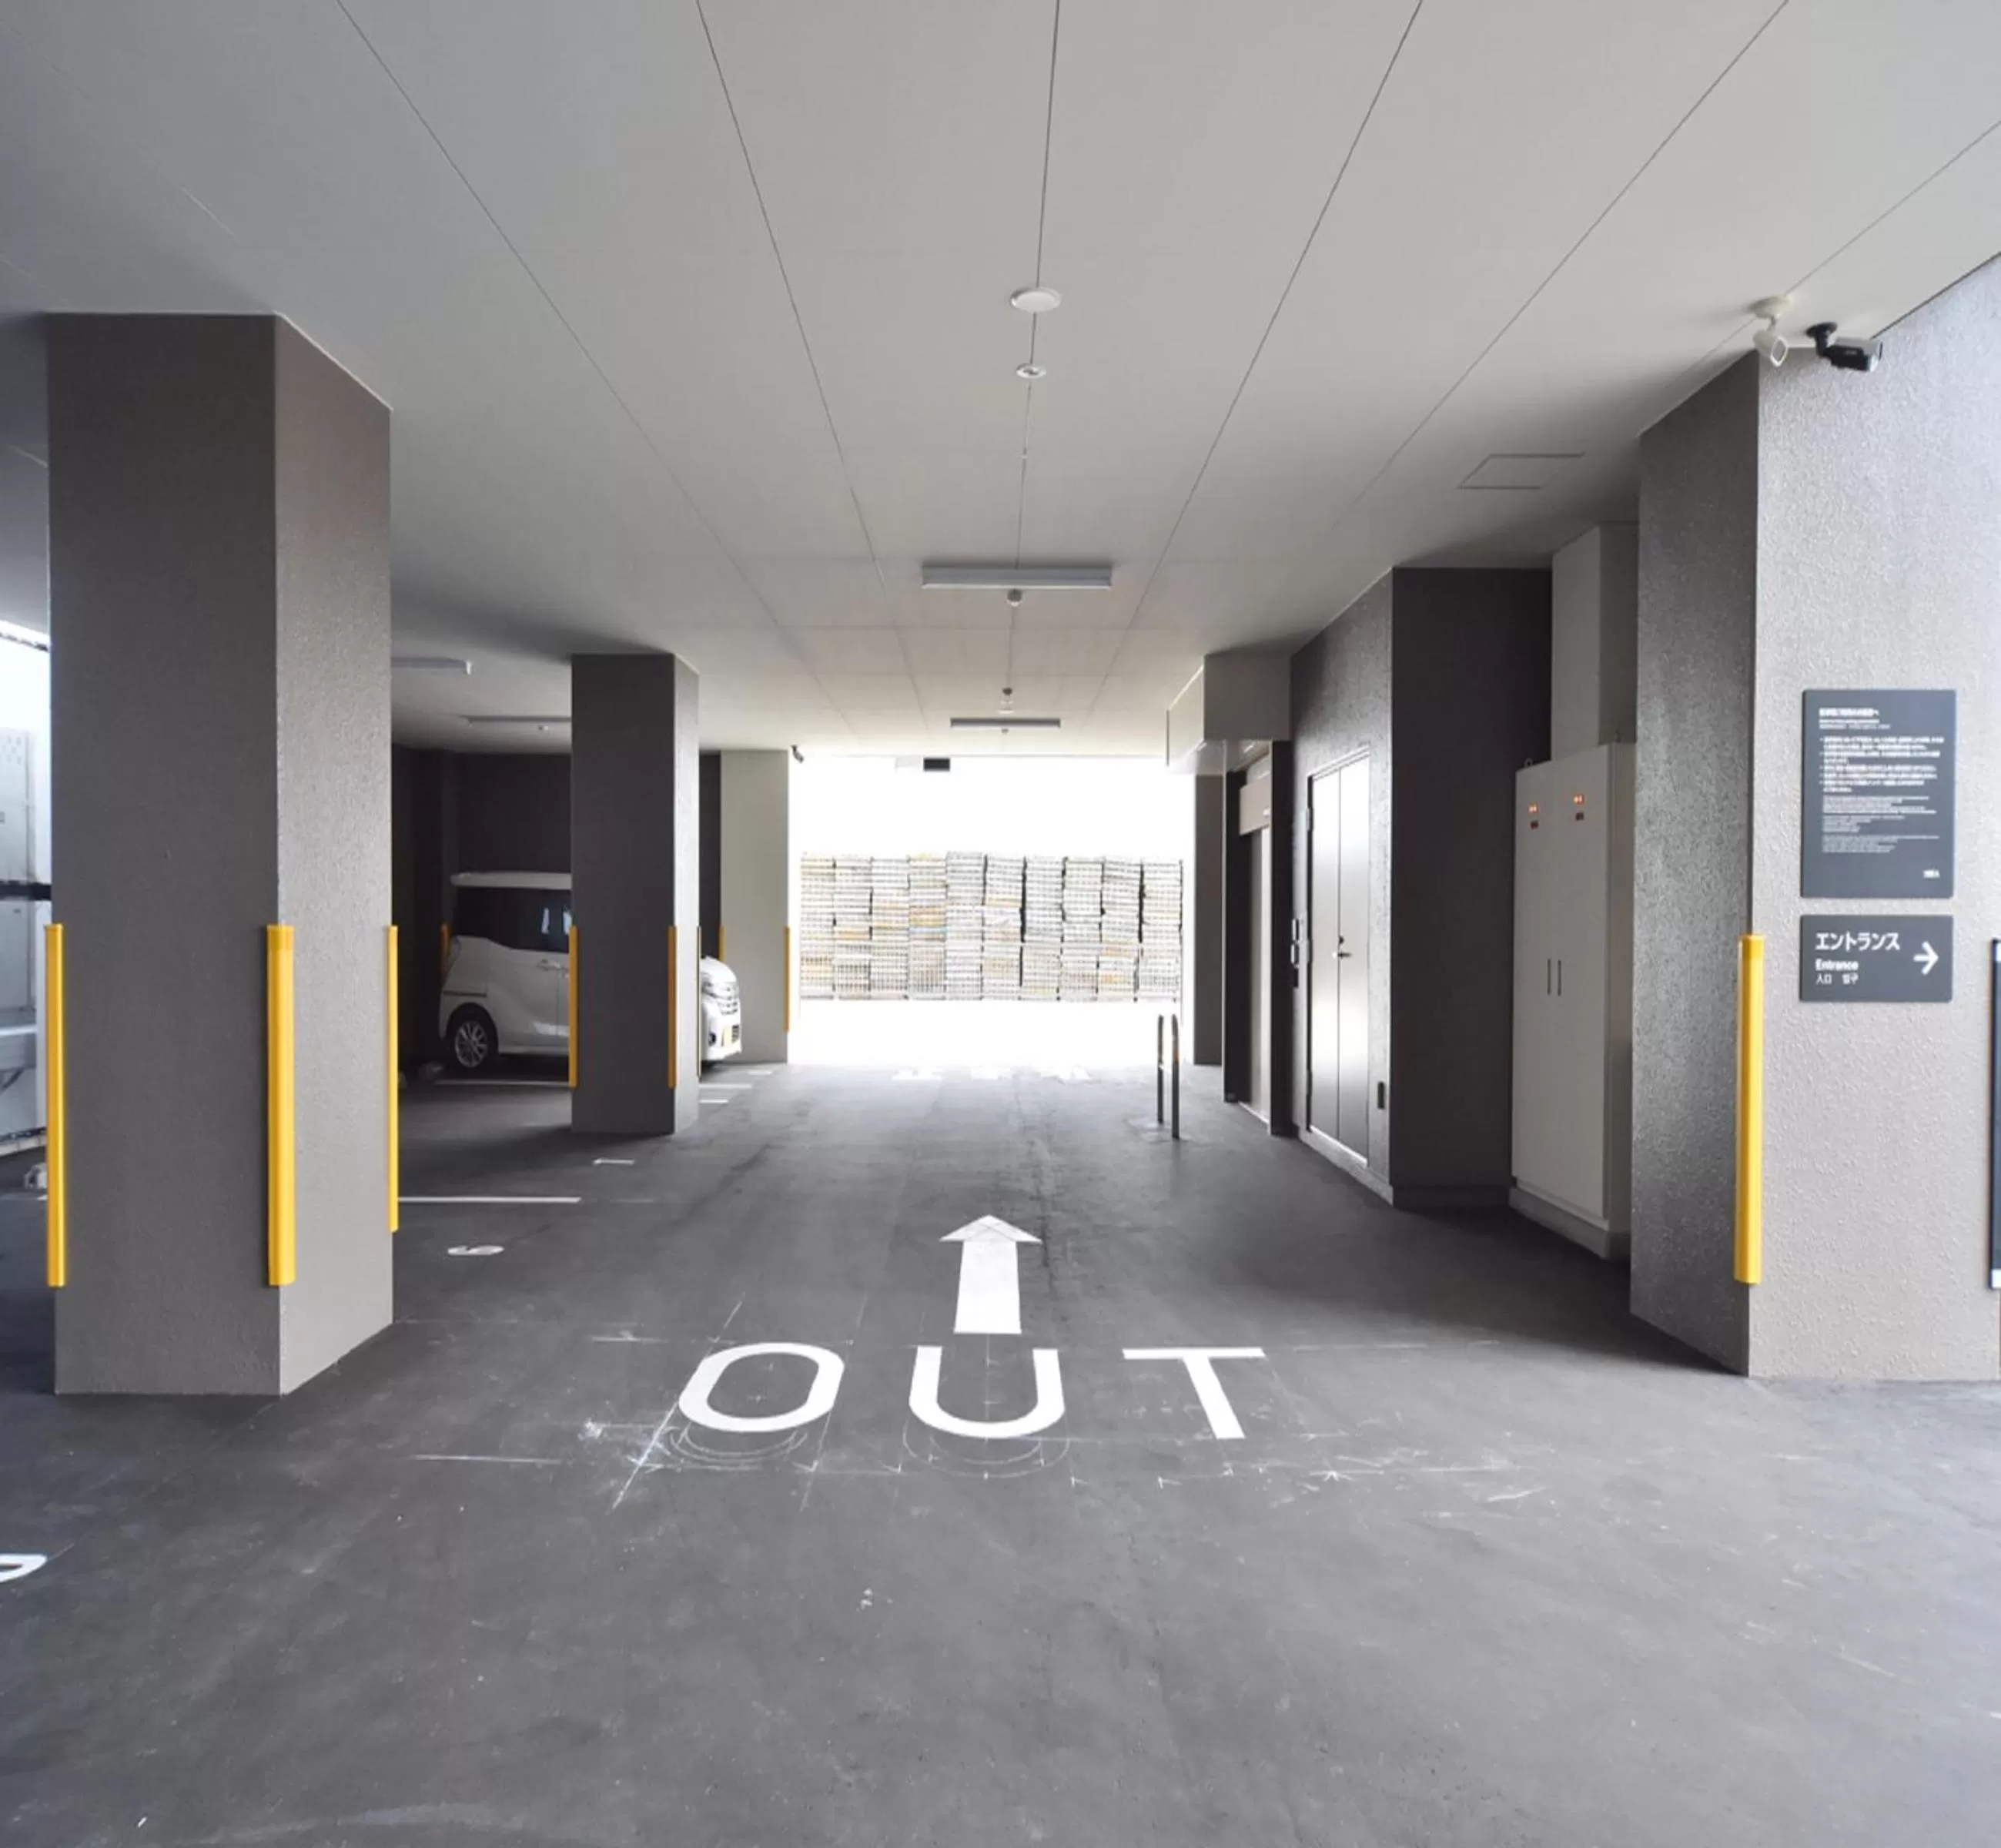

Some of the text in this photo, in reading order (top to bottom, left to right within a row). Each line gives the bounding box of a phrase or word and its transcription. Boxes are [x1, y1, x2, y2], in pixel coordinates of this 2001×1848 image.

[1815, 931, 1900, 952] エントランス
[1815, 958, 1859, 971] Entrance
[678, 1342, 1265, 1439] OUT
